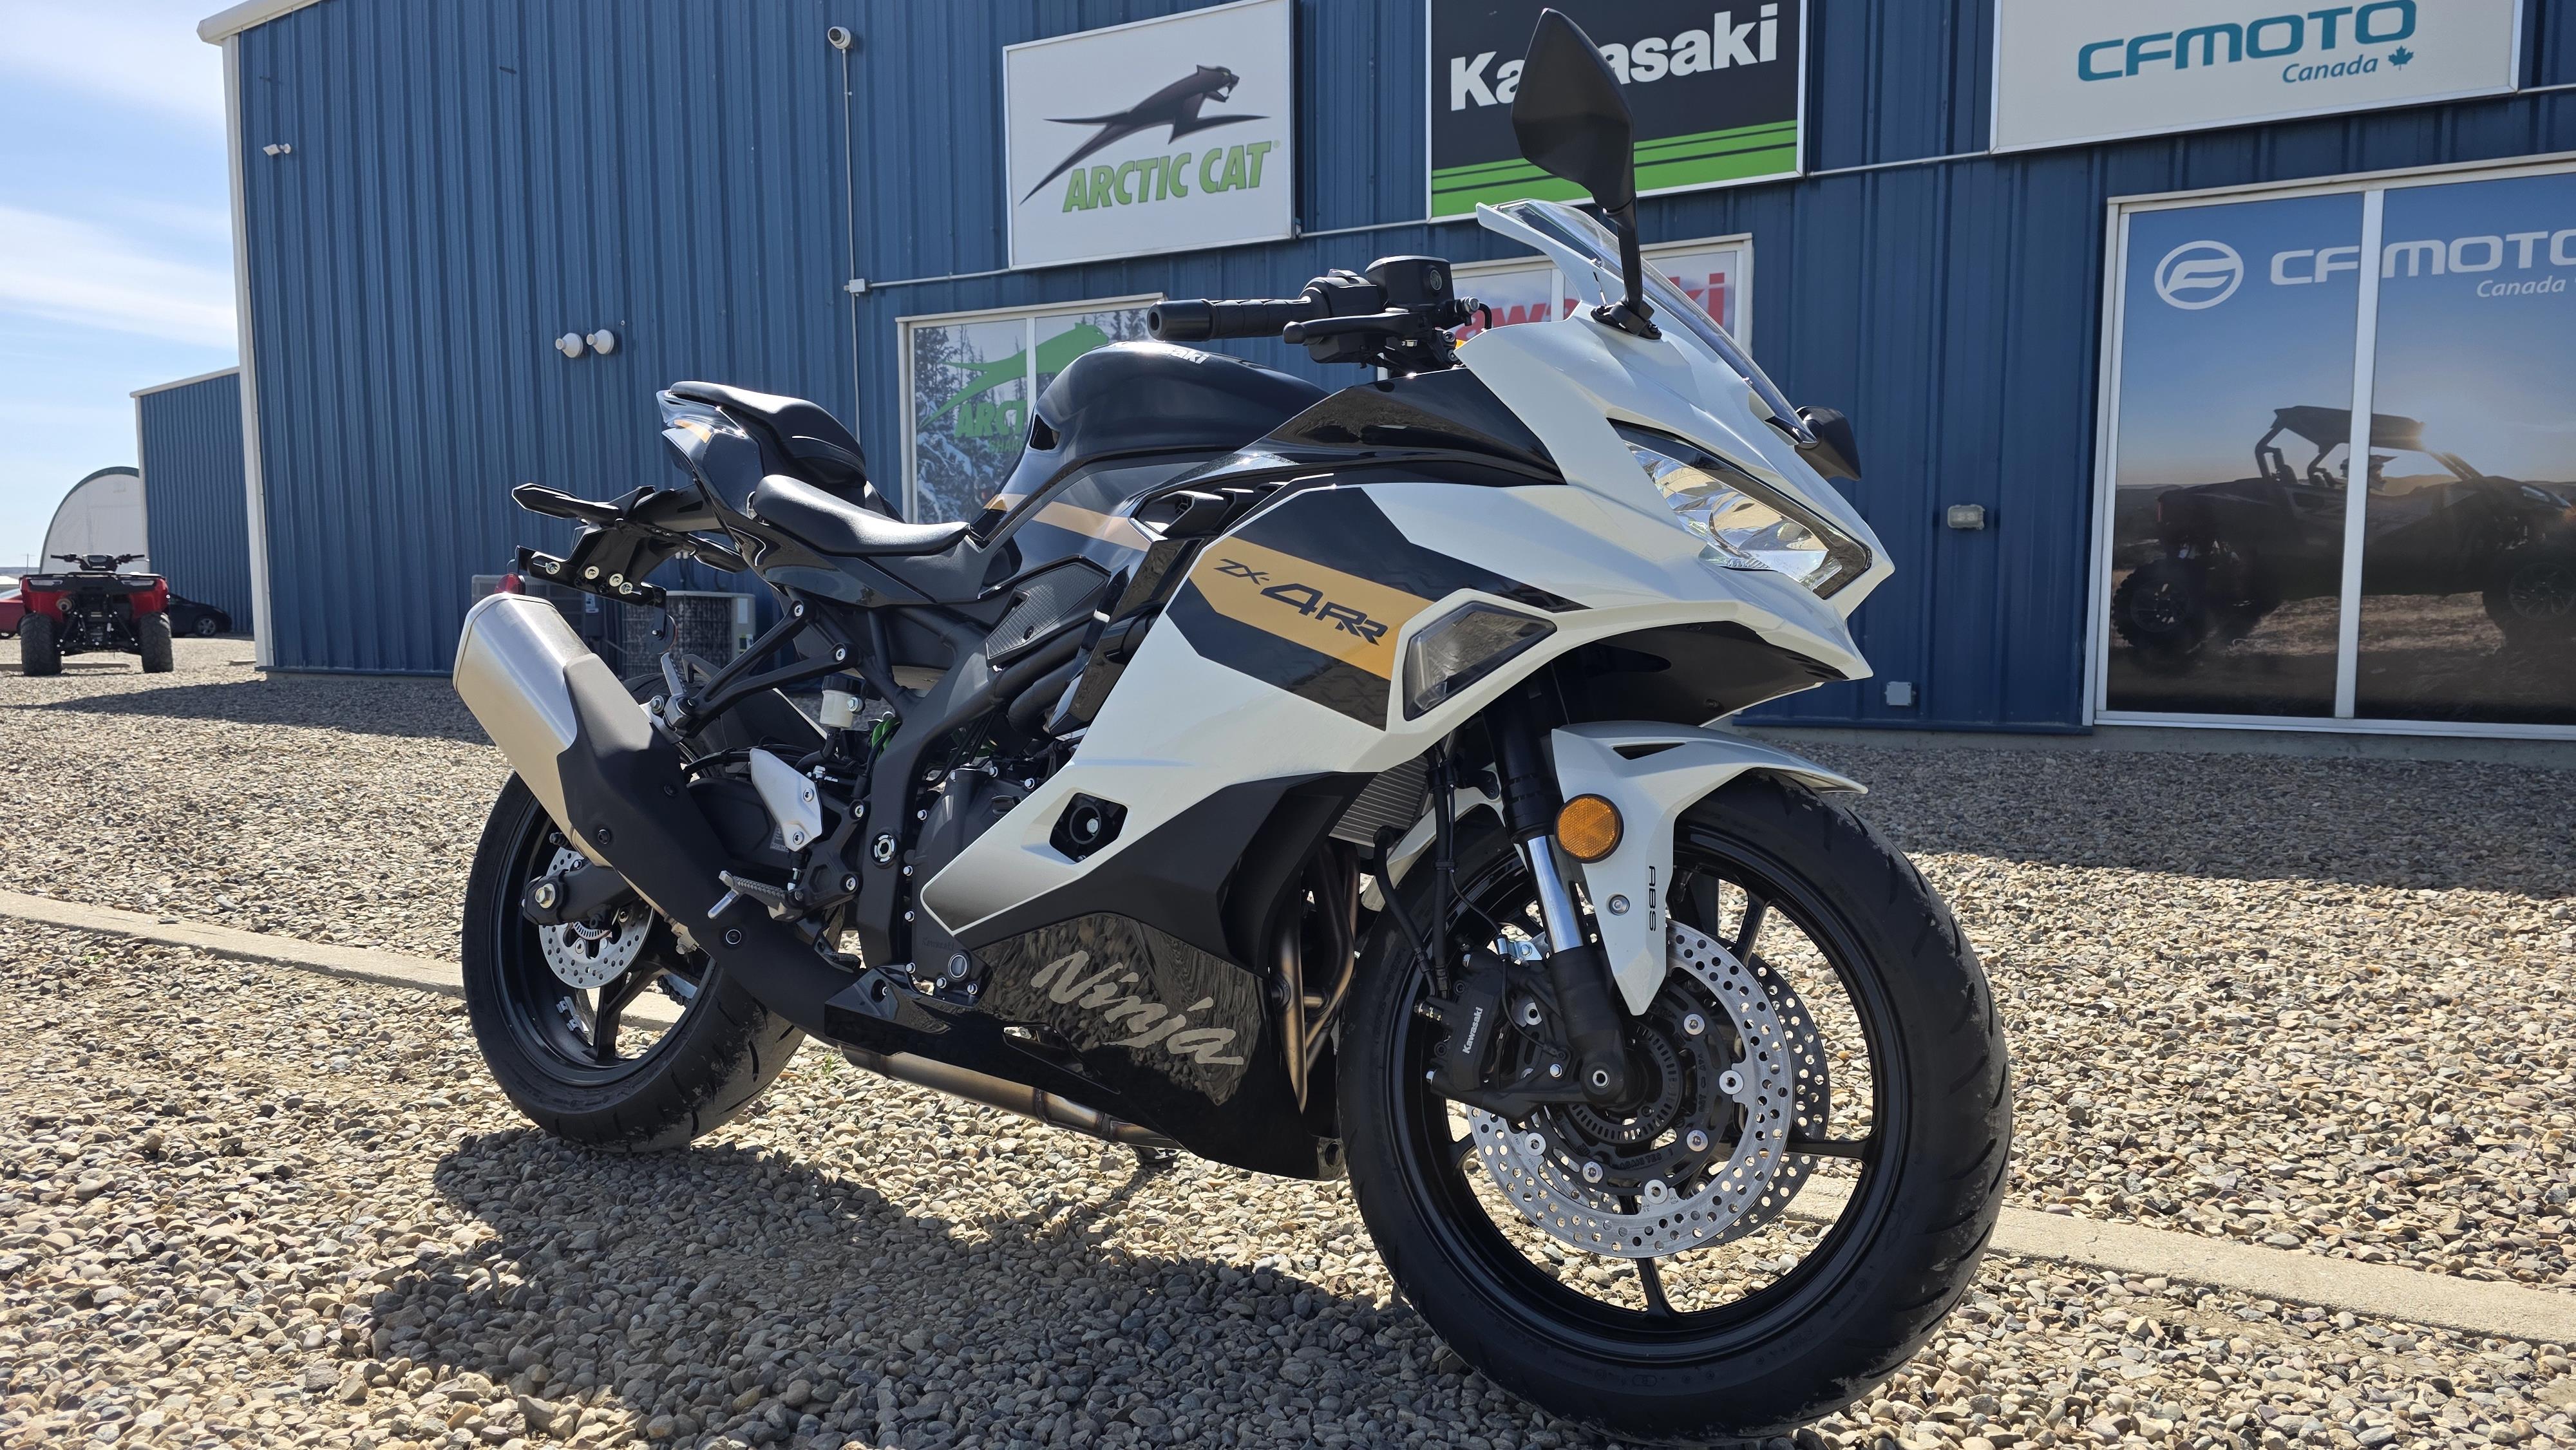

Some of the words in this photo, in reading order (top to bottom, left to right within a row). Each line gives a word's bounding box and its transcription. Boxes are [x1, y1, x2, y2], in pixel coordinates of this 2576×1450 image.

[1450, 3, 1778, 111] Kaasaki
[2078, 0, 2417, 82] CFMOTO
[2282, 54, 2378, 84] Canada
[1062, 152, 1191, 212] ARCTIC
[1198, 140, 1272, 194] CAT
[2476, 275, 2566, 297] Canada
[954, 400, 1027, 438] ARCT
[1649, 865, 1657, 932] ABS
[1030, 950, 1244, 1065] Ninja
[1462, 1006, 1483, 1055] Kawasaki
